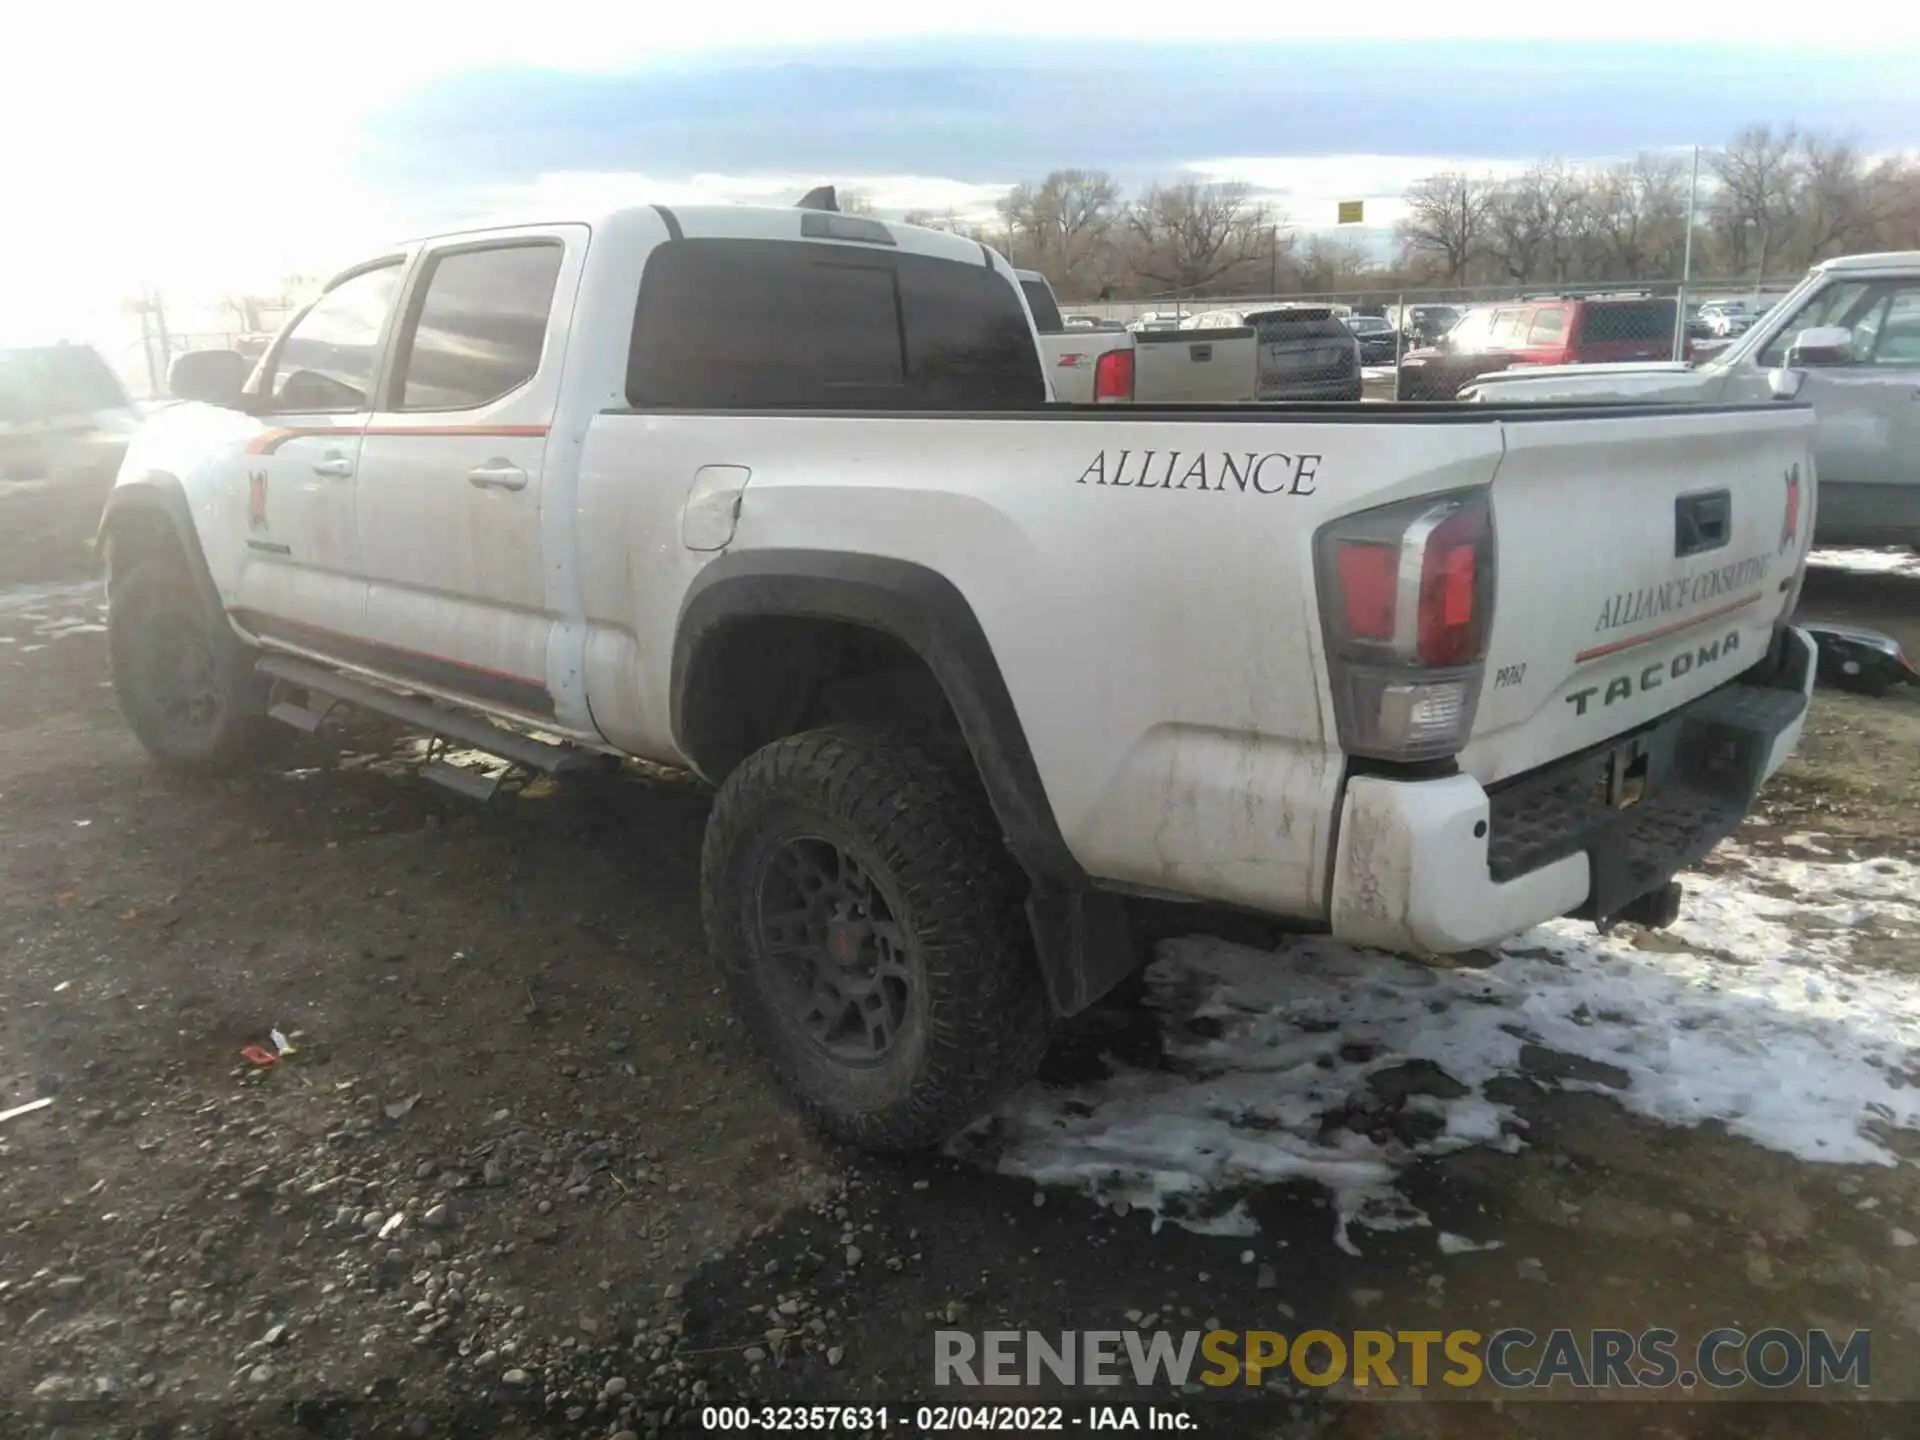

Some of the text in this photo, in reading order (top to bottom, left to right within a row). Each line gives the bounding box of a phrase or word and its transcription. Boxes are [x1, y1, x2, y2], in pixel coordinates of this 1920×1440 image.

[1076, 449, 1322, 496] ALLIANCE
[1594, 575, 1691, 632] ALLIANCE
[1565, 629, 1741, 717] TACOMA
